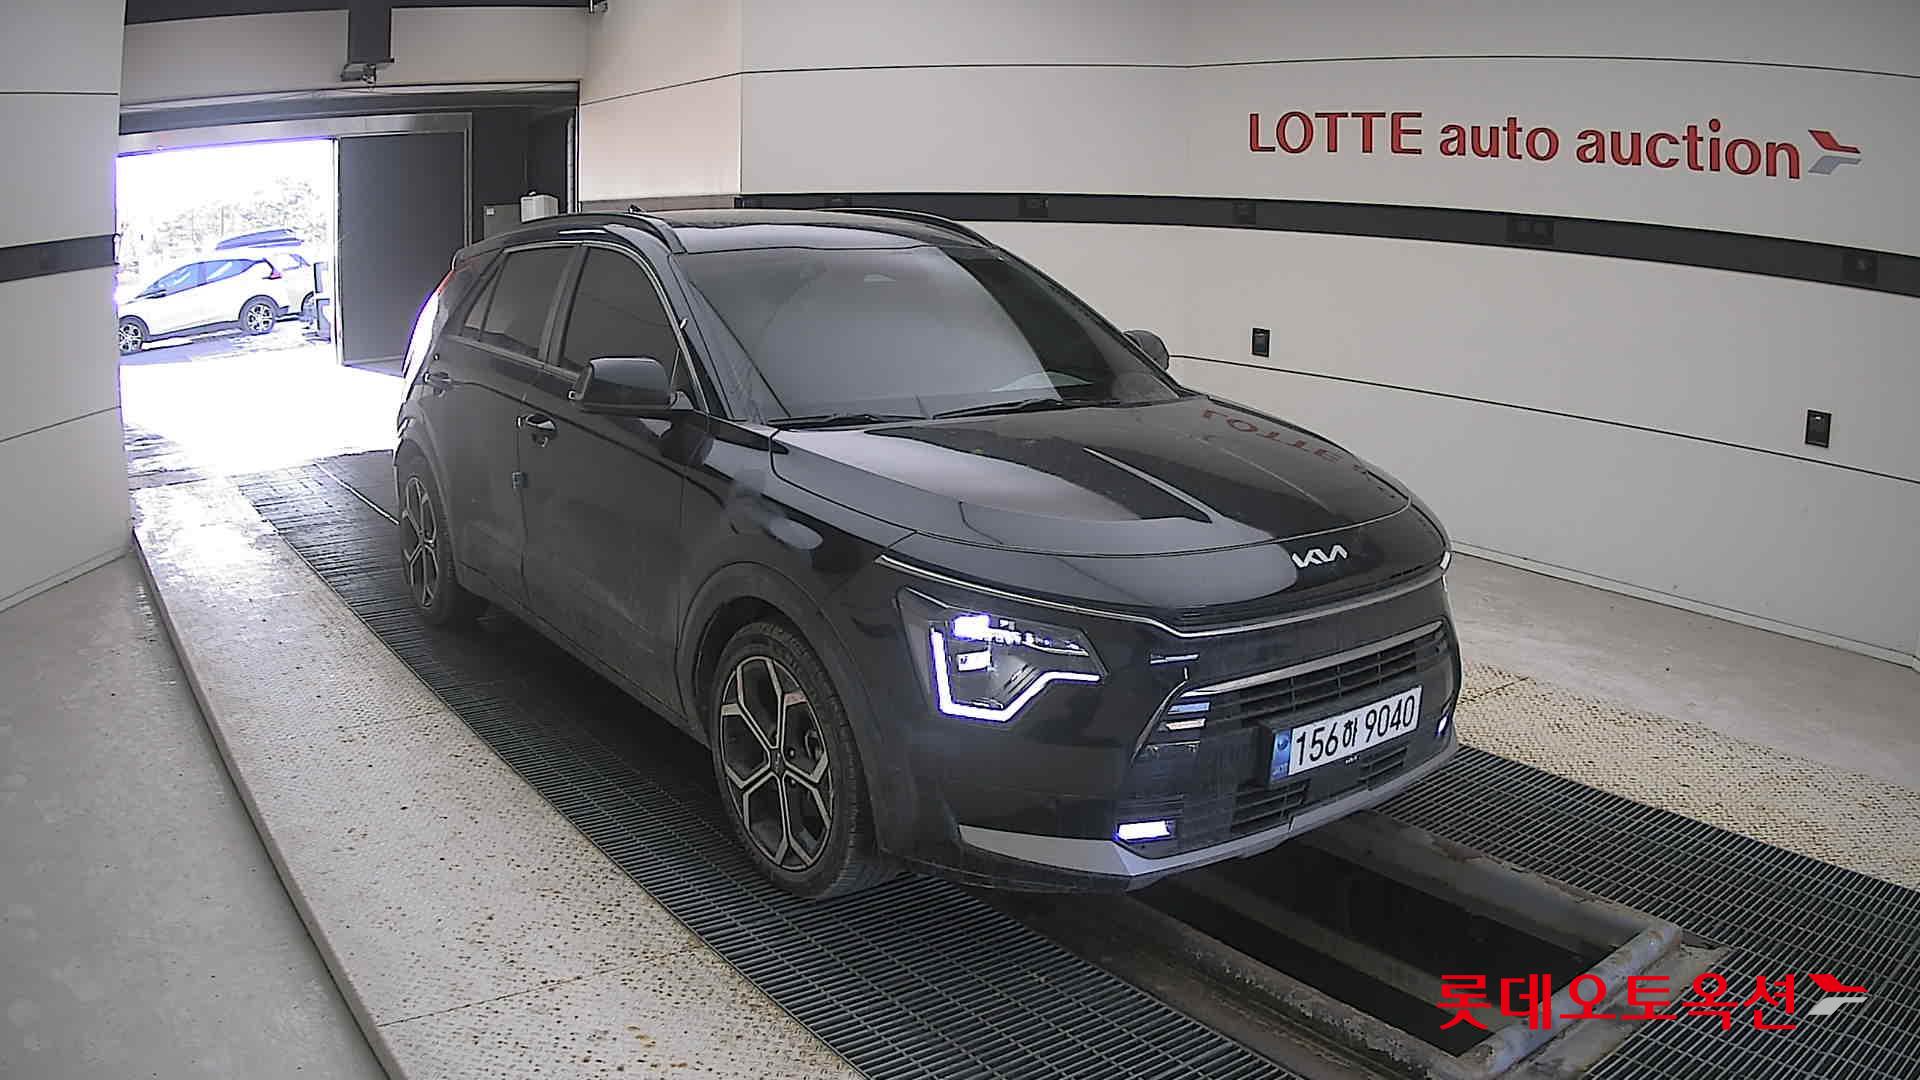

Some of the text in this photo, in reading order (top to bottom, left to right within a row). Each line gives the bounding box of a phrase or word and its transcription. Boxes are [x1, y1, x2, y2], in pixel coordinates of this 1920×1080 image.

[1249, 111, 1801, 179] LOTTE auto auction
[1296, 695, 1416, 766] 156하 9040
